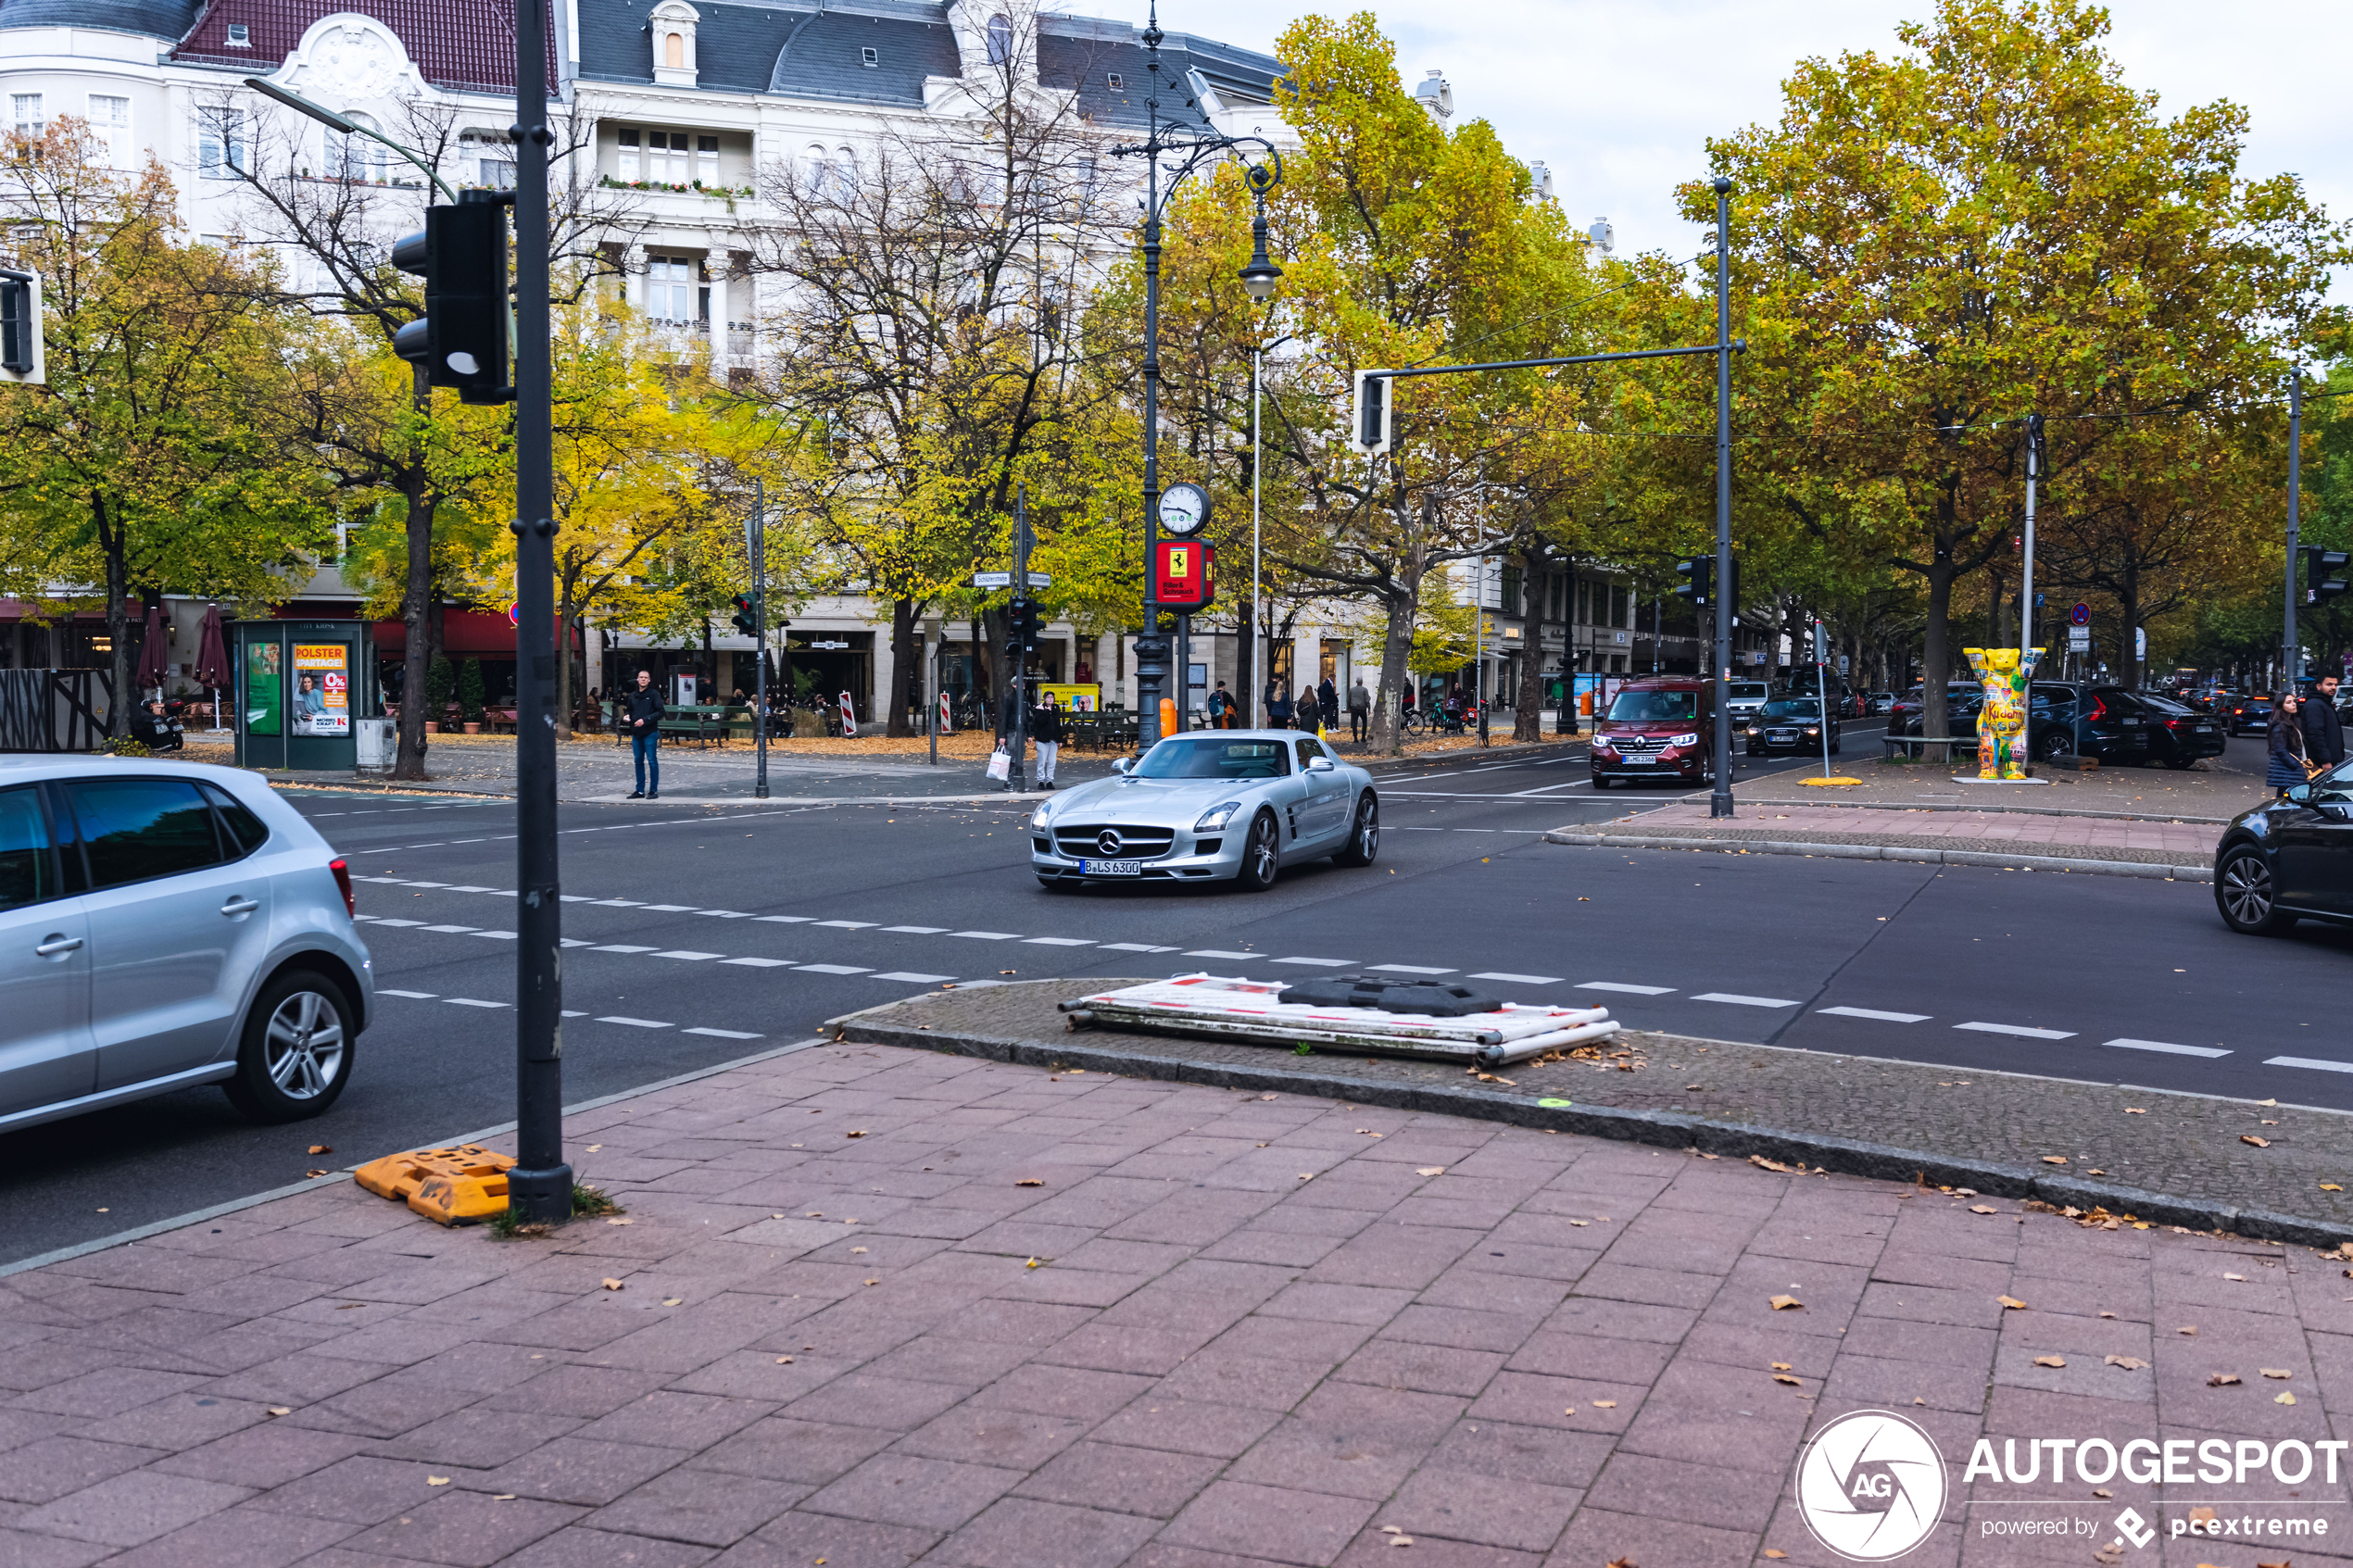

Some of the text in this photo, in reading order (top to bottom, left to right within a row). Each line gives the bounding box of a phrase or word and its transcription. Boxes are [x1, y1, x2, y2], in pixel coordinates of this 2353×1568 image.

[296, 648, 342, 657] POLSTER
[296, 659, 343, 667] SPARTAGE!
[325, 672, 345, 686] 0%
[1098, 862, 1111, 872] LS
[1113, 862, 1139, 873] 6300
